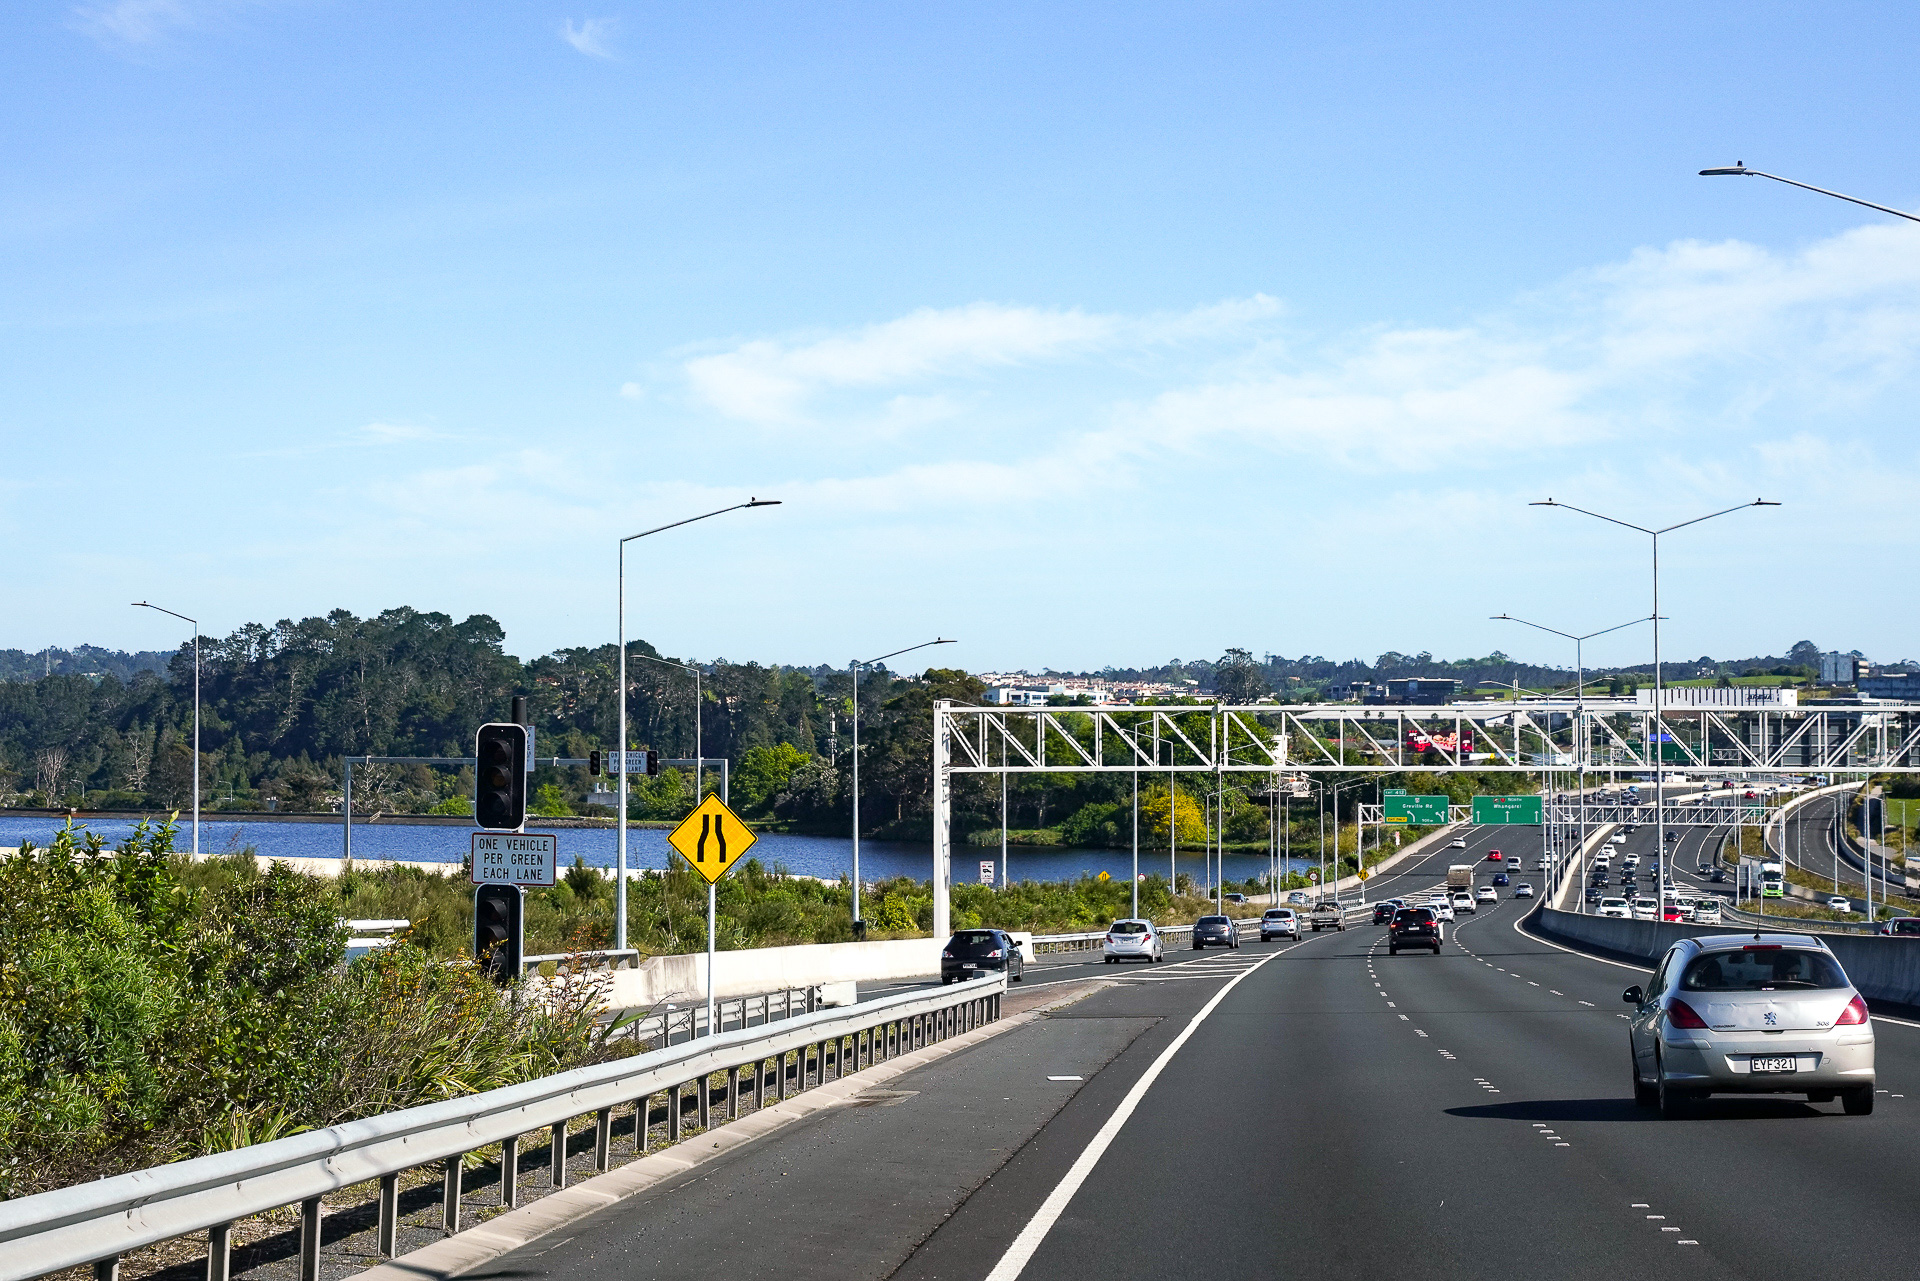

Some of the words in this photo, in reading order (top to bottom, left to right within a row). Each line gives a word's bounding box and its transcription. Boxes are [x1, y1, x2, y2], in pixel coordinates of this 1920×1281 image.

[479, 838, 498, 850] ONE
[506, 839, 549, 852] VEHICLE
[484, 853, 503, 864] PER
[511, 853, 543, 866] GREEN
[483, 867, 509, 879] EACH
[516, 868, 543, 880] LANE
[1753, 1059, 1794, 1070] EYF321
